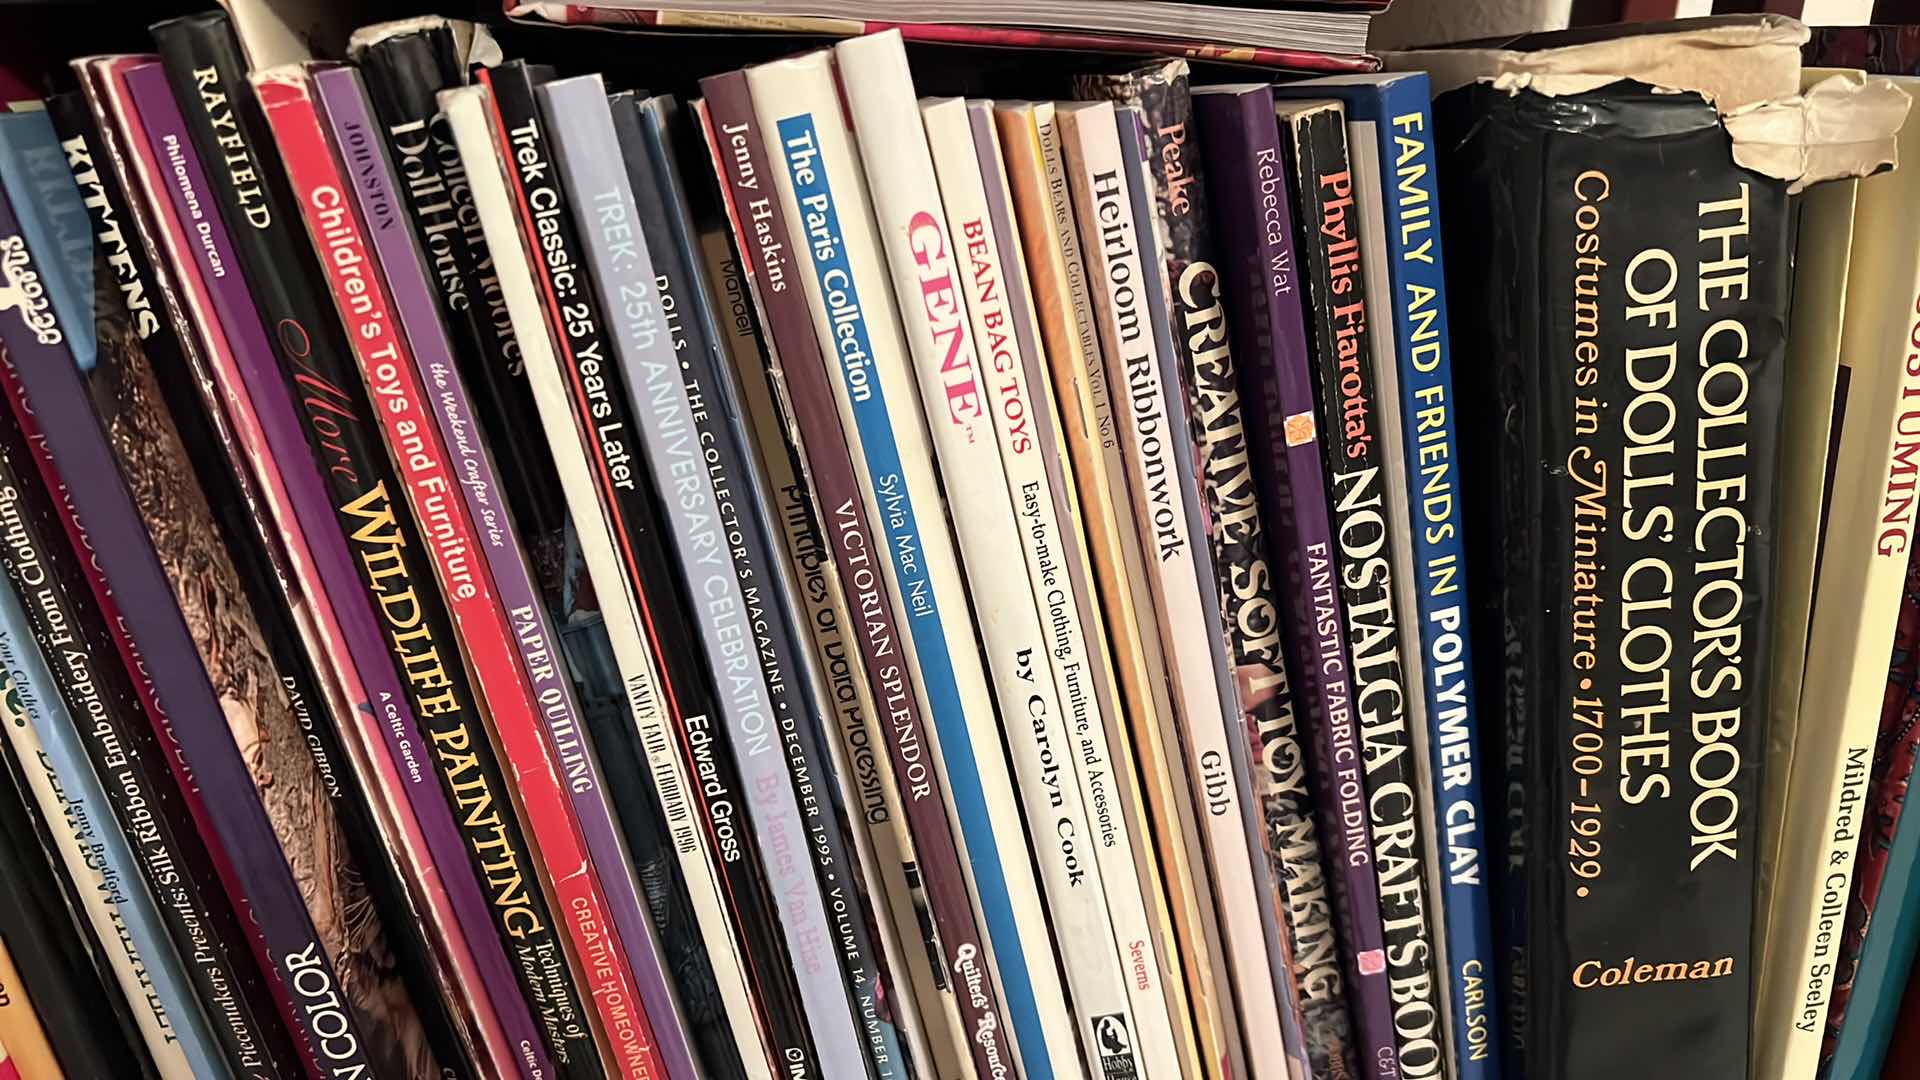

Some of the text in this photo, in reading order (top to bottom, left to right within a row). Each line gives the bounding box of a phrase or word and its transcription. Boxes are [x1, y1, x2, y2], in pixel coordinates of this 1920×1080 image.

[163, 134, 225, 277] Philomena Durcan
[193, 65, 271, 229] RAYFIELD
[390, 119, 470, 311] Doll House
[722, 123, 786, 292] Jenny Haskins
[1157, 121, 1197, 217] Peake
[1257, 147, 1291, 296] Rebecca Wat
[61, 134, 160, 341] KITTENS
[511, 119, 634, 492] Trek Classic: 25 Years Later
[787, 129, 871, 402] The Paris Collection
[1574, 170, 1609, 387] Costumes
[963, 216, 1032, 455] BEAN BAG TOYS
[1094, 169, 1185, 563] Heirloom Ribbonwork
[1320, 171, 1372, 458] Phyllis Fiarotta's
[277, 319, 359, 484] More
[311, 185, 476, 600] Children's Toys and Furniture
[430, 362, 447, 391] the
[440, 391, 477, 457] Weekend
[1104, 440, 1114, 448] 6
[1575, 398, 1608, 436] in
[0, 486, 45, 585] Clothing
[594, 186, 771, 757] TREK: 25th ANNIVERSARY CELEBRATION
[879, 473, 933, 618] Sylvia Mac Neil
[1392, 112, 1480, 886] FAMILY AND FRIENDS IN POLYMER CLAY
[1619, 248, 1678, 804] OF DOLLS' CLOTHES
[1690, 182, 1750, 872] THE COLLECTOR'S BOOK
[40, 589, 73, 647] From
[1178, 261, 1342, 1000] CREATIVE SOFT TOY MAKING
[1567, 446, 1607, 670] Miniature
[11, 669, 40, 720] Clothes
[64, 647, 124, 769] Embroidery
[340, 479, 544, 939] WILDLIFE PAINTING
[512, 605, 591, 794] PAPER QUILLING
[655, 275, 687, 352] DOLLS
[686, 379, 708, 422] THE
[700, 431, 752, 580] COLLECTOR'S
[745, 587, 784, 695] MAGAZINE
[782, 719, 819, 817] DECEMBER
[812, 824, 832, 866] 1995
[830, 887, 860, 961] VOLUME
[861, 996, 888, 1065] NUMBER
[835, 497, 931, 802] VICTORIAN SPLENDOR
[1021, 480, 1116, 848] Easy-to-make Clothing, Furniture, and Accessories
[1307, 542, 1368, 867] FANTASTIC FABRIC FOLDING
[119, 772, 160, 844] Ribbon
[282, 675, 342, 798] DAVID GIBBON
[379, 691, 423, 784] A Celtic Garden
[628, 674, 697, 854] VANITY FAIR FEBRUARY 1996
[685, 714, 740, 863] Edward Gross
[1016, 648, 1085, 888] by Carolyn Cook
[1201, 750, 1231, 816] Gibb
[1334, 466, 1441, 1080] NOSTALGIA CRAFTS BOO
[68, 798, 128, 905] Jenny Bradford
[149, 846, 180, 885] Silk
[171, 887, 214, 964] Presents:
[1795, 747, 1869, 1034] Mildred & Colleen Seeley
[285, 942, 357, 1060] COLOR
[515, 944, 570, 1065] Modern Masters
[535, 938, 589, 1040] Techniques of
[571, 896, 613, 980] CREATIVE
[954, 943, 990, 1010] Quilters'
[1128, 940, 1150, 991] Severns
[1462, 959, 1489, 1061] CARLSON
[1572, 957, 1735, 988] Coleman
[207, 967, 262, 1068] Piecemakers
[520, 1040, 540, 1068] Celtic
[1102, 1056, 1133, 1071] Hobby
